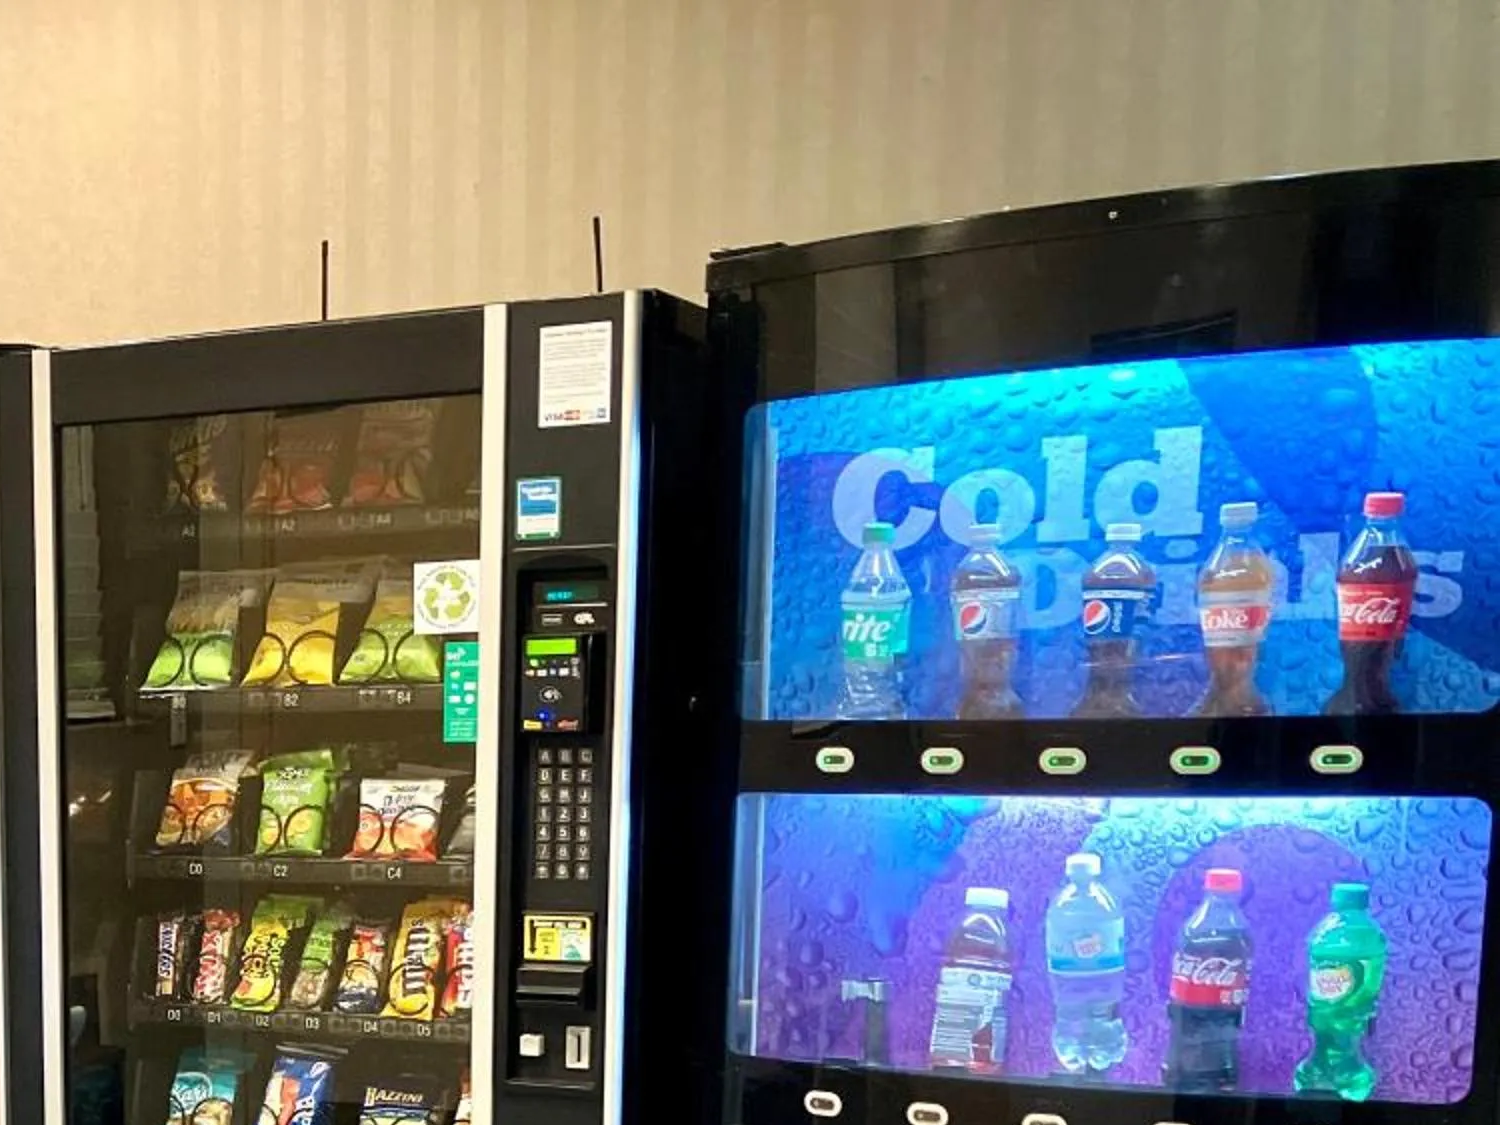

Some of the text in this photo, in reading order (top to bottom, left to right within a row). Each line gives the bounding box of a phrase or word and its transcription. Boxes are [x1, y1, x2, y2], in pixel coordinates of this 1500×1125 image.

[832, 426, 1202, 551] Cold
[273, 865, 288, 877] C2
[387, 866, 402, 879] C4
[363, 1020, 378, 1033] D4
